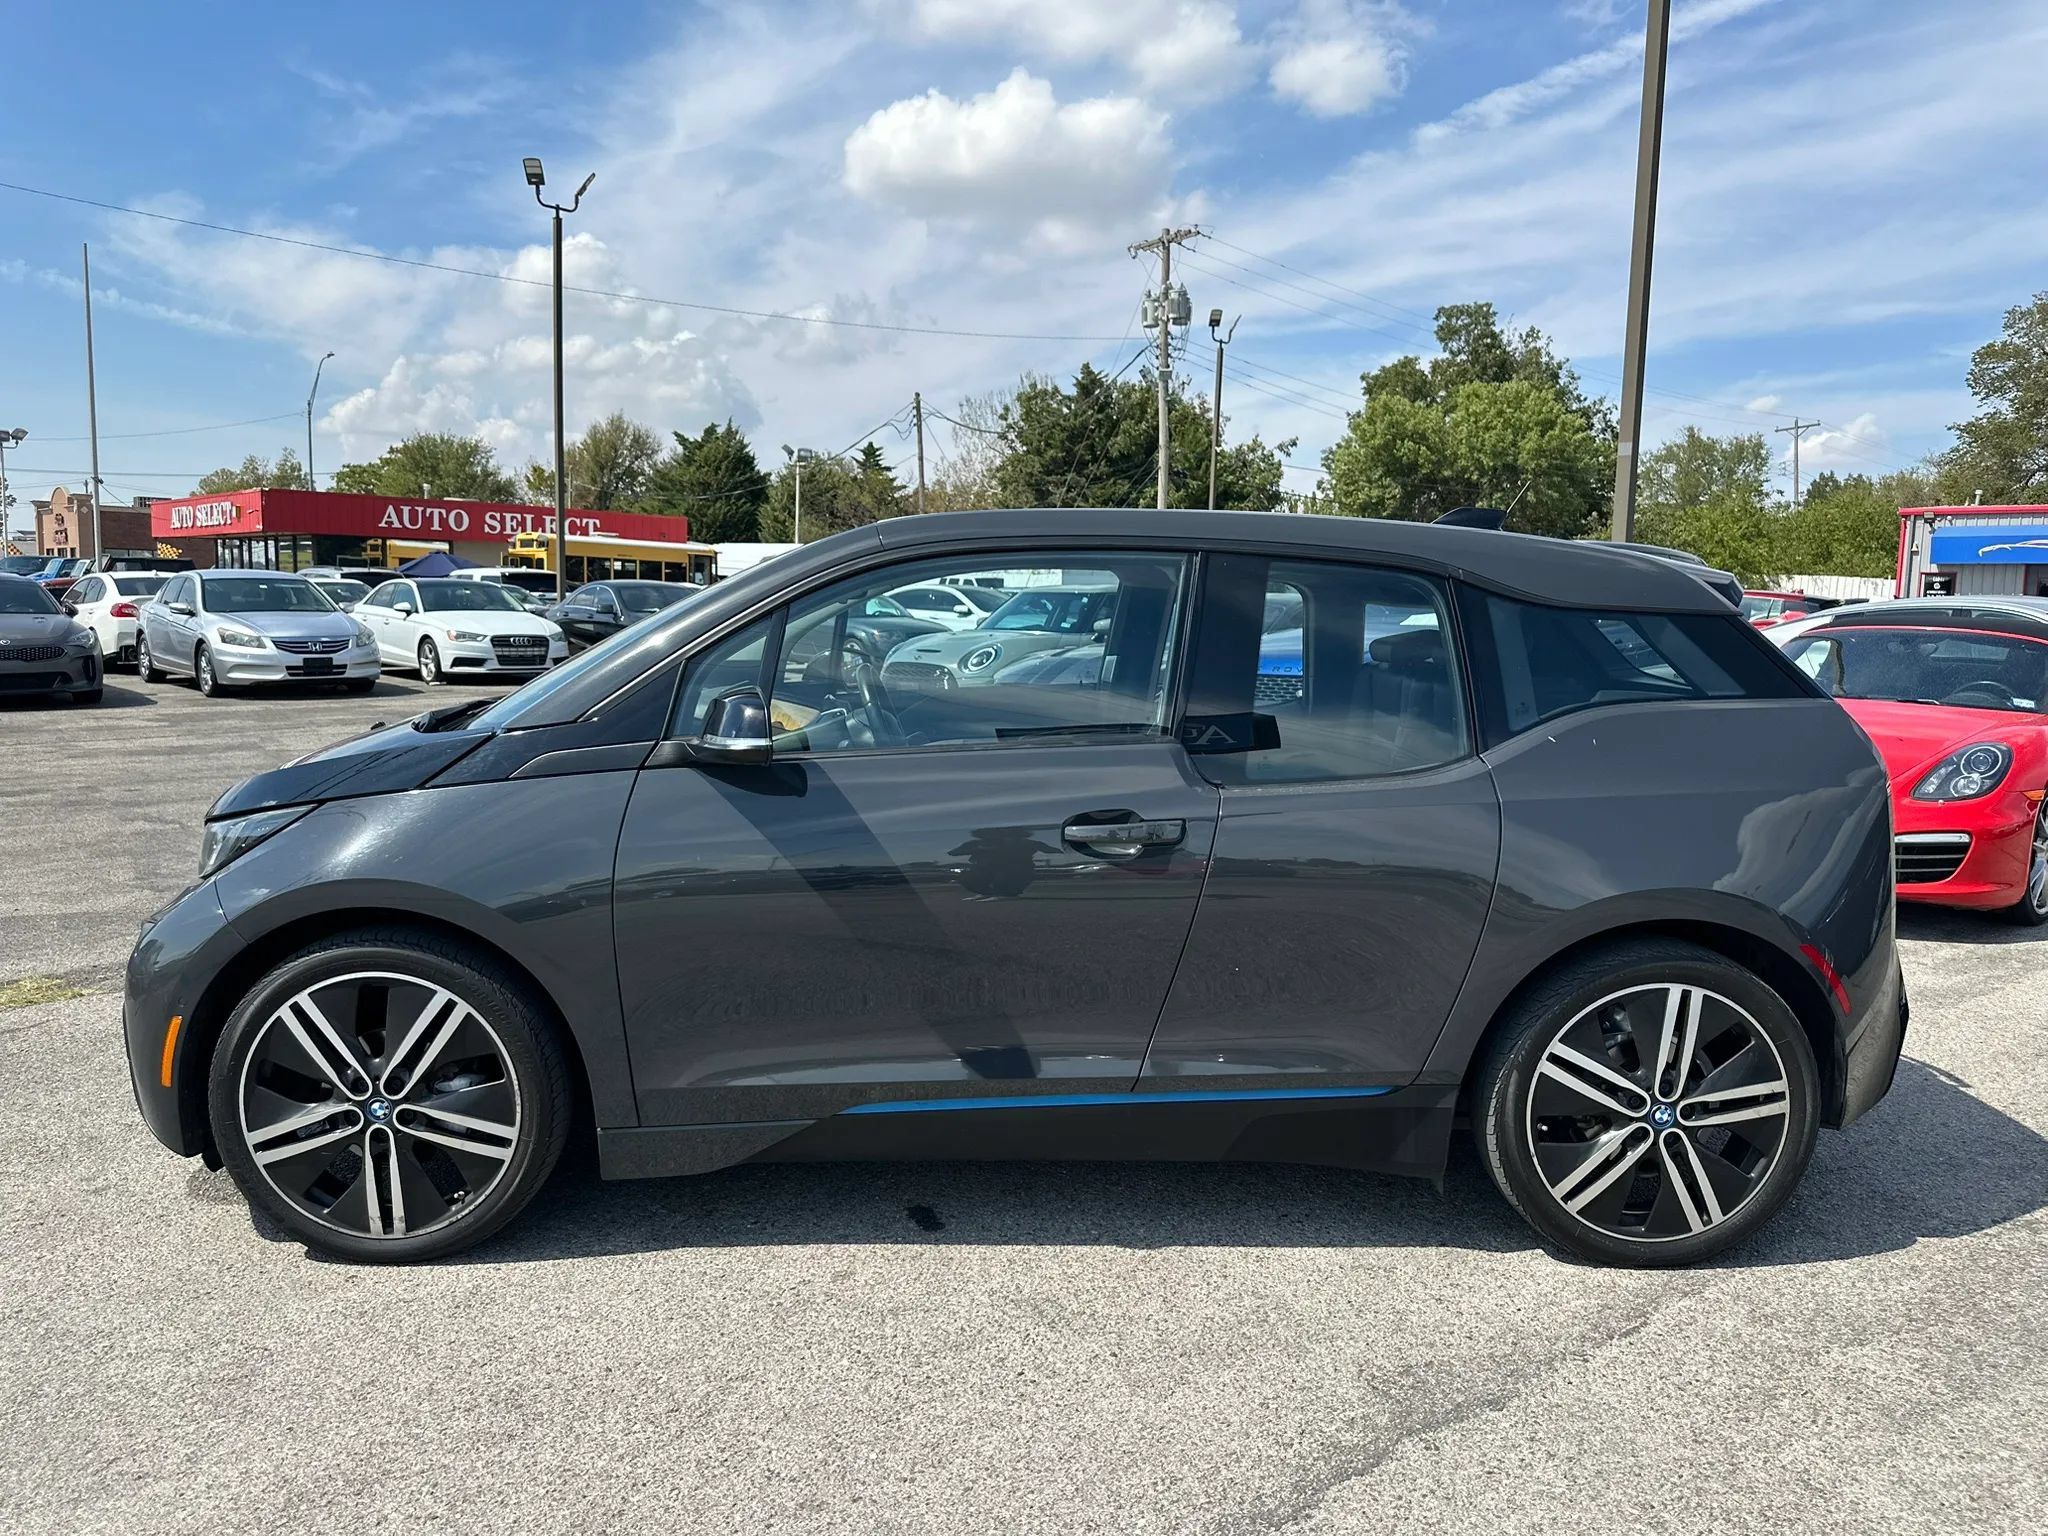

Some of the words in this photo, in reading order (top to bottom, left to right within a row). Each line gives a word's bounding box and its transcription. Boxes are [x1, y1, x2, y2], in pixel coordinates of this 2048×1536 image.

[170, 506, 194, 528] AUTO
[195, 501, 232, 527] SELECT
[378, 505, 469, 531] AUTO
[484, 511, 601, 536] SELECT
